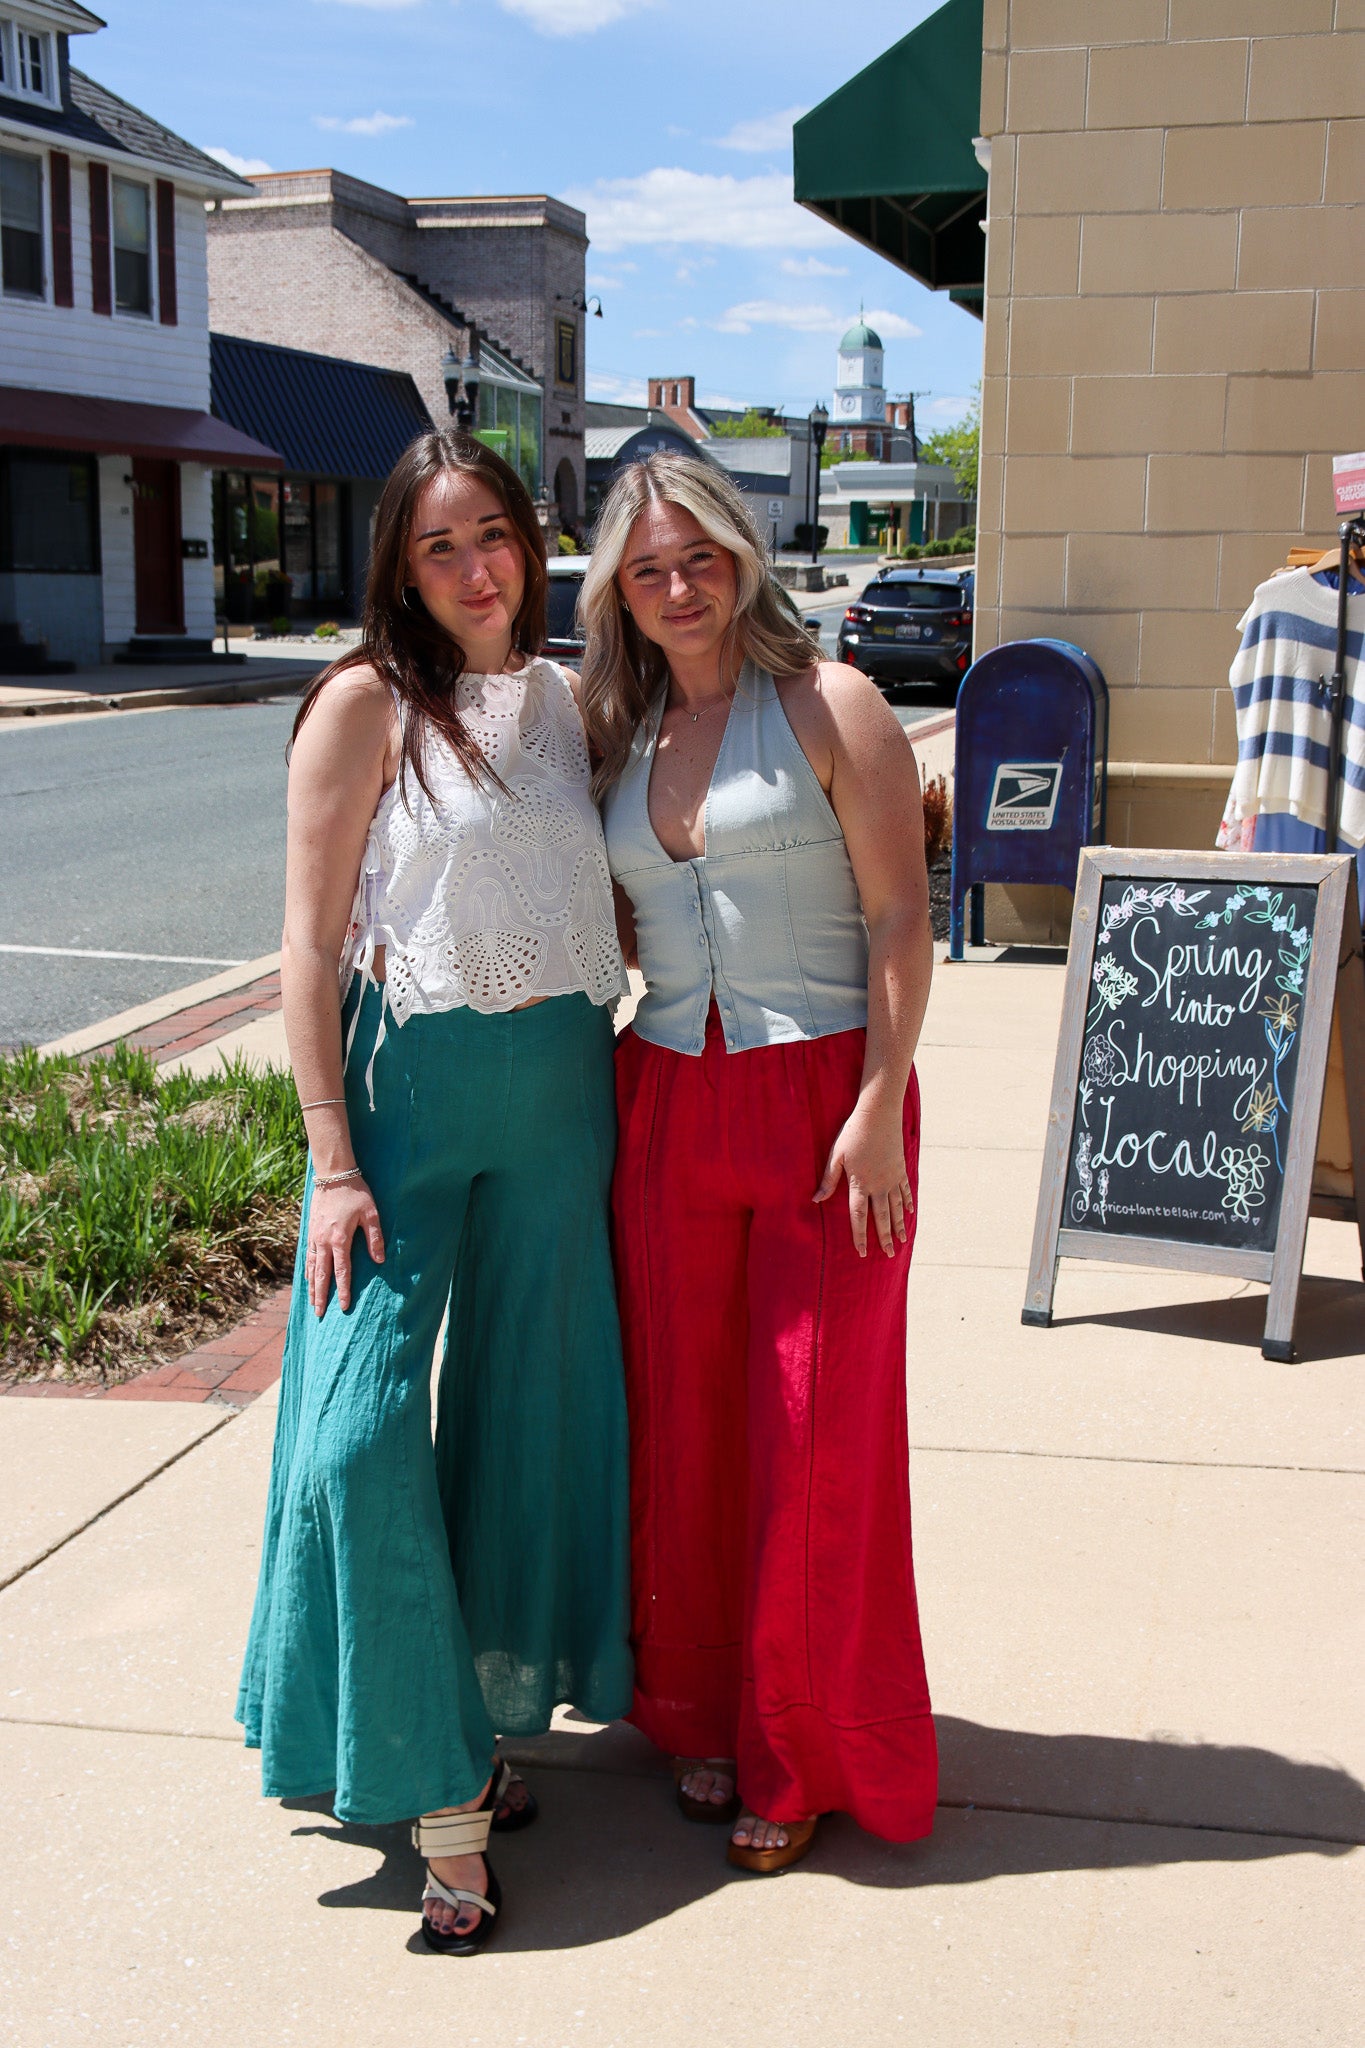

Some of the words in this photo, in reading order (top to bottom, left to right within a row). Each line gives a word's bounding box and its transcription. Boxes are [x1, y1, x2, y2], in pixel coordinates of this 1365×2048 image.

[1336, 483, 1365, 496] CUSTO
[992, 811, 1020, 819] UNITED
[1020, 811, 1046, 819] STATES
[1131, 916, 1272, 1013] Spring
[1170, 990, 1236, 1027] into
[1107, 1019, 1267, 1121] Shopping
[1091, 1095, 1228, 1179] Local
